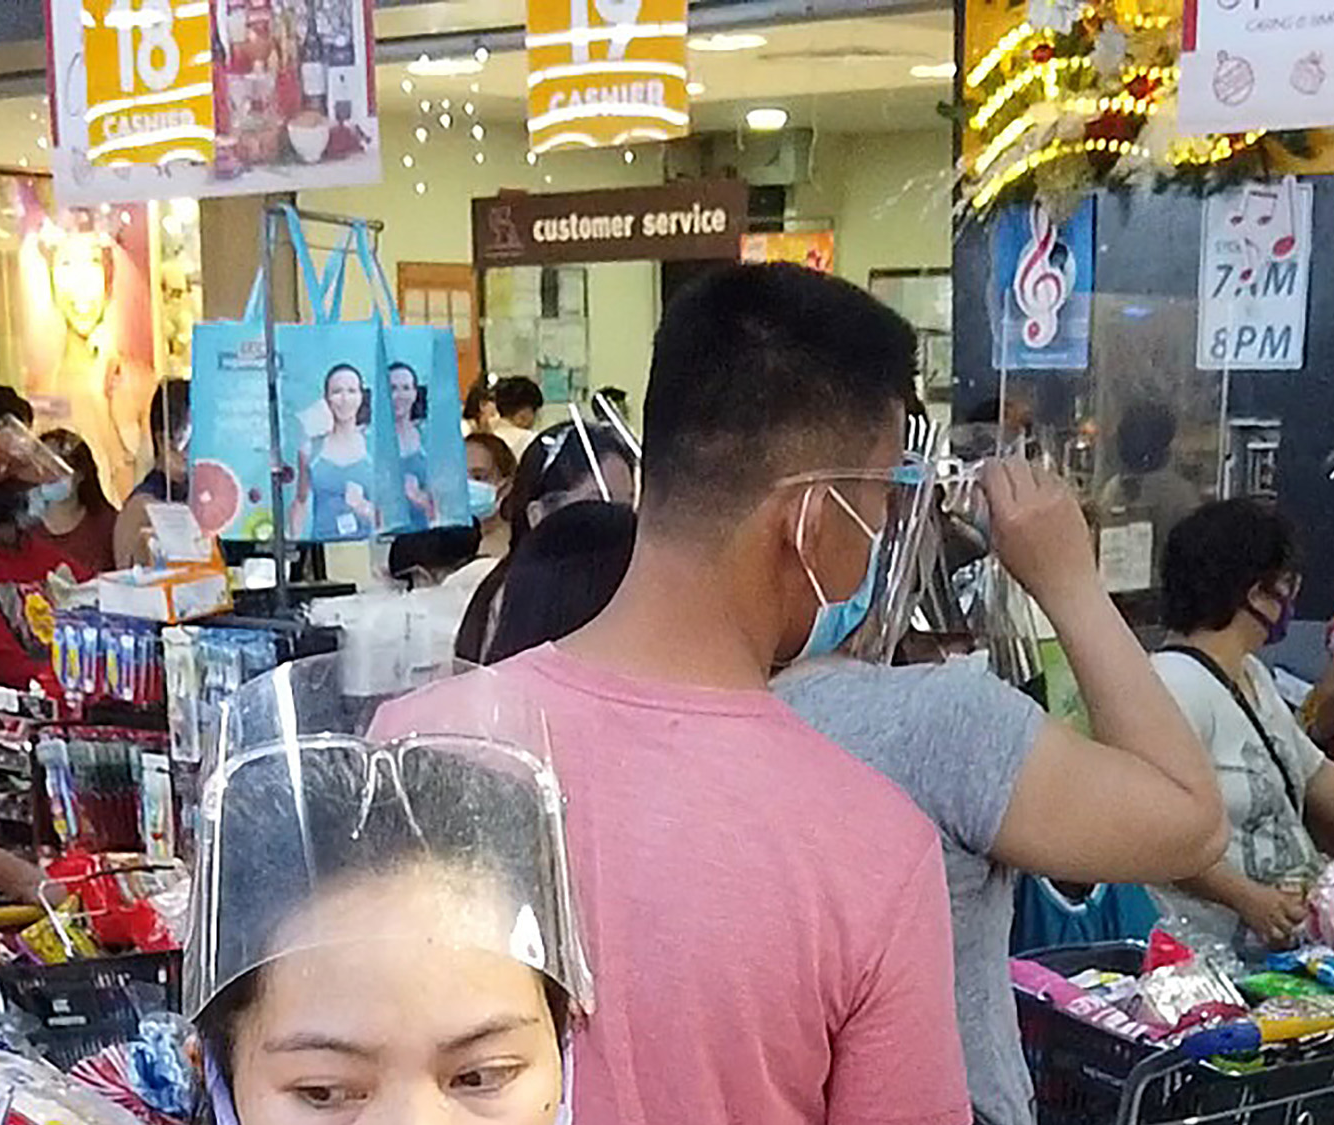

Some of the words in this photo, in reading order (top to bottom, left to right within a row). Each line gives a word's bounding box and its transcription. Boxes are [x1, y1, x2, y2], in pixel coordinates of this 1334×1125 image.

[116, 0, 180, 92] 18
[548, 78, 666, 114] CASHIER
[102, 108, 196, 139] CASHIER
[532, 212, 635, 242] customer
[641, 202, 727, 236] service
[1209, 325, 1292, 361] 8PM
